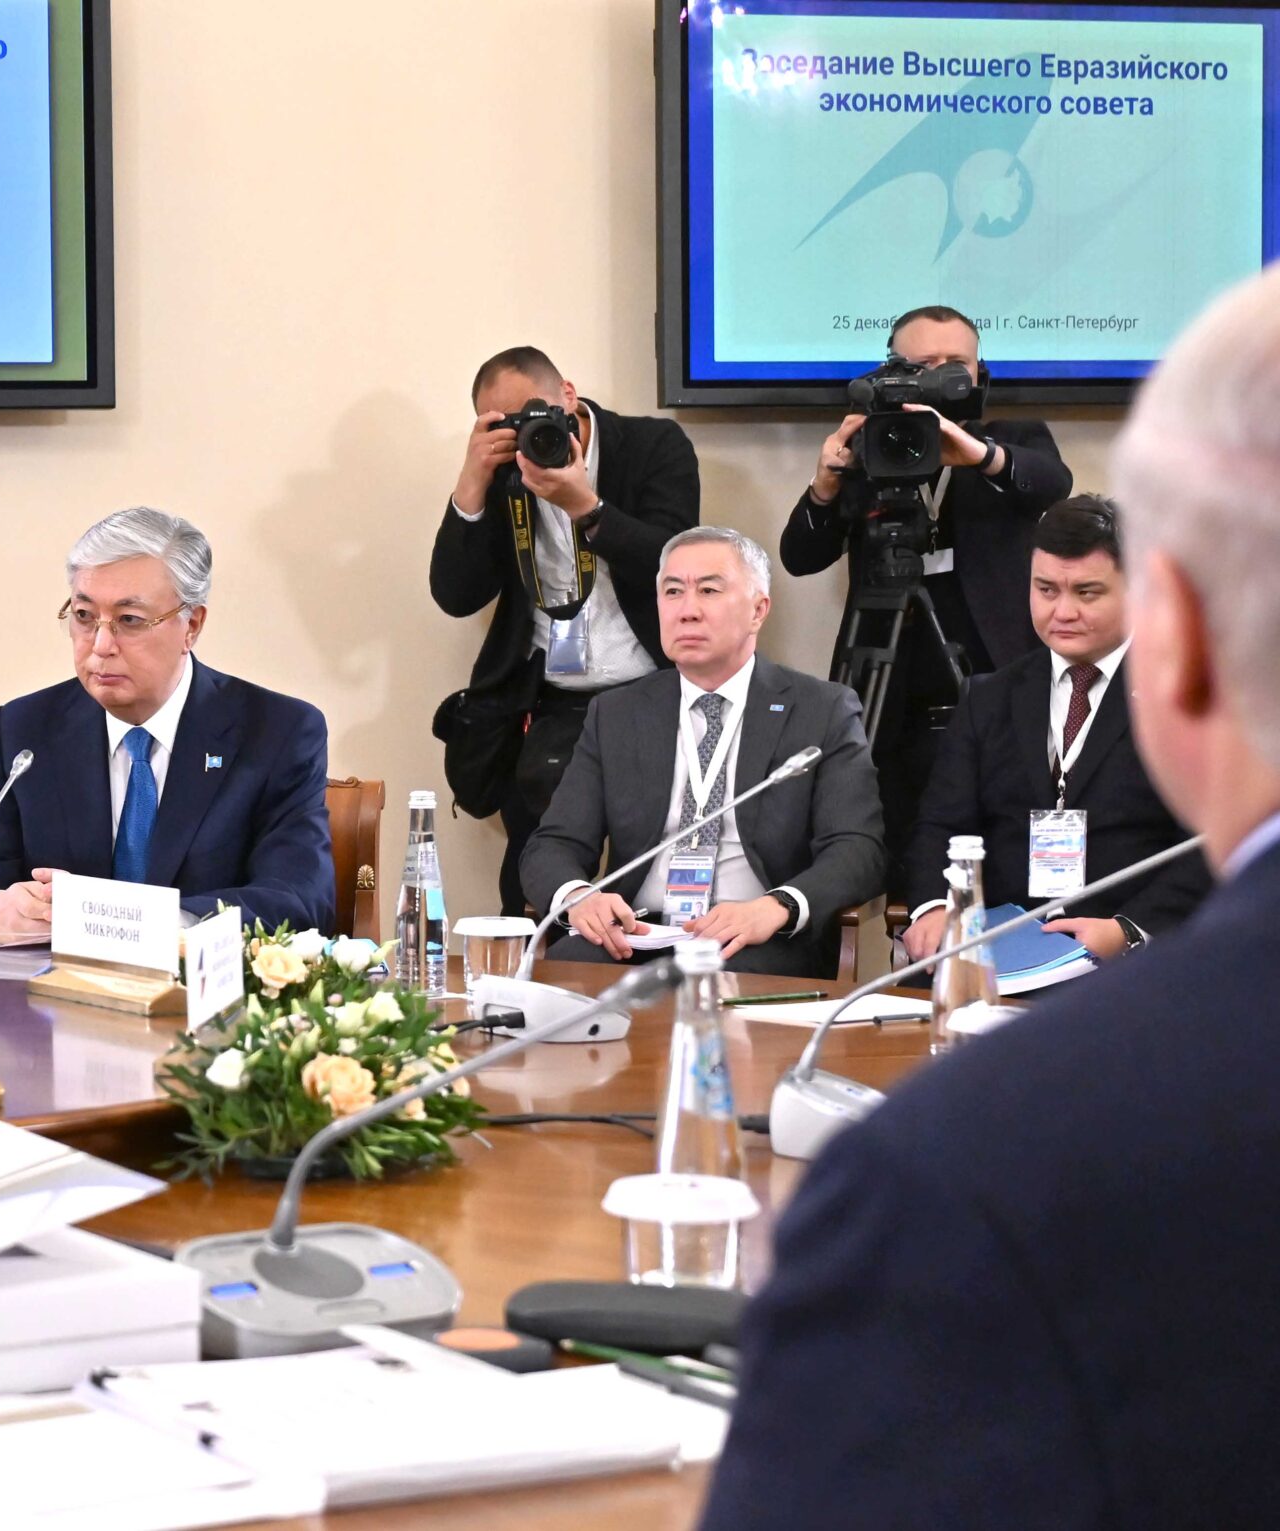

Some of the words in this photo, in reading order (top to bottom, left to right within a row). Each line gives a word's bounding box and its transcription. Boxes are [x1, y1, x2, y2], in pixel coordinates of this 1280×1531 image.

[903, 51, 1032, 78] Высшего
[1040, 53, 1228, 85] Евразийского
[819, 92, 1052, 115] экономического
[1060, 95, 1154, 116] совета
[832, 314, 851, 330] 25
[854, 314, 895, 333] декаб
[970, 317, 992, 332] да
[1004, 317, 1014, 329] г.
[1017, 314, 1139, 333] Санкт-Петербург
[81, 900, 142, 922] СВОБОДНЫЙ
[84, 921, 140, 943] МИКРОФОН
